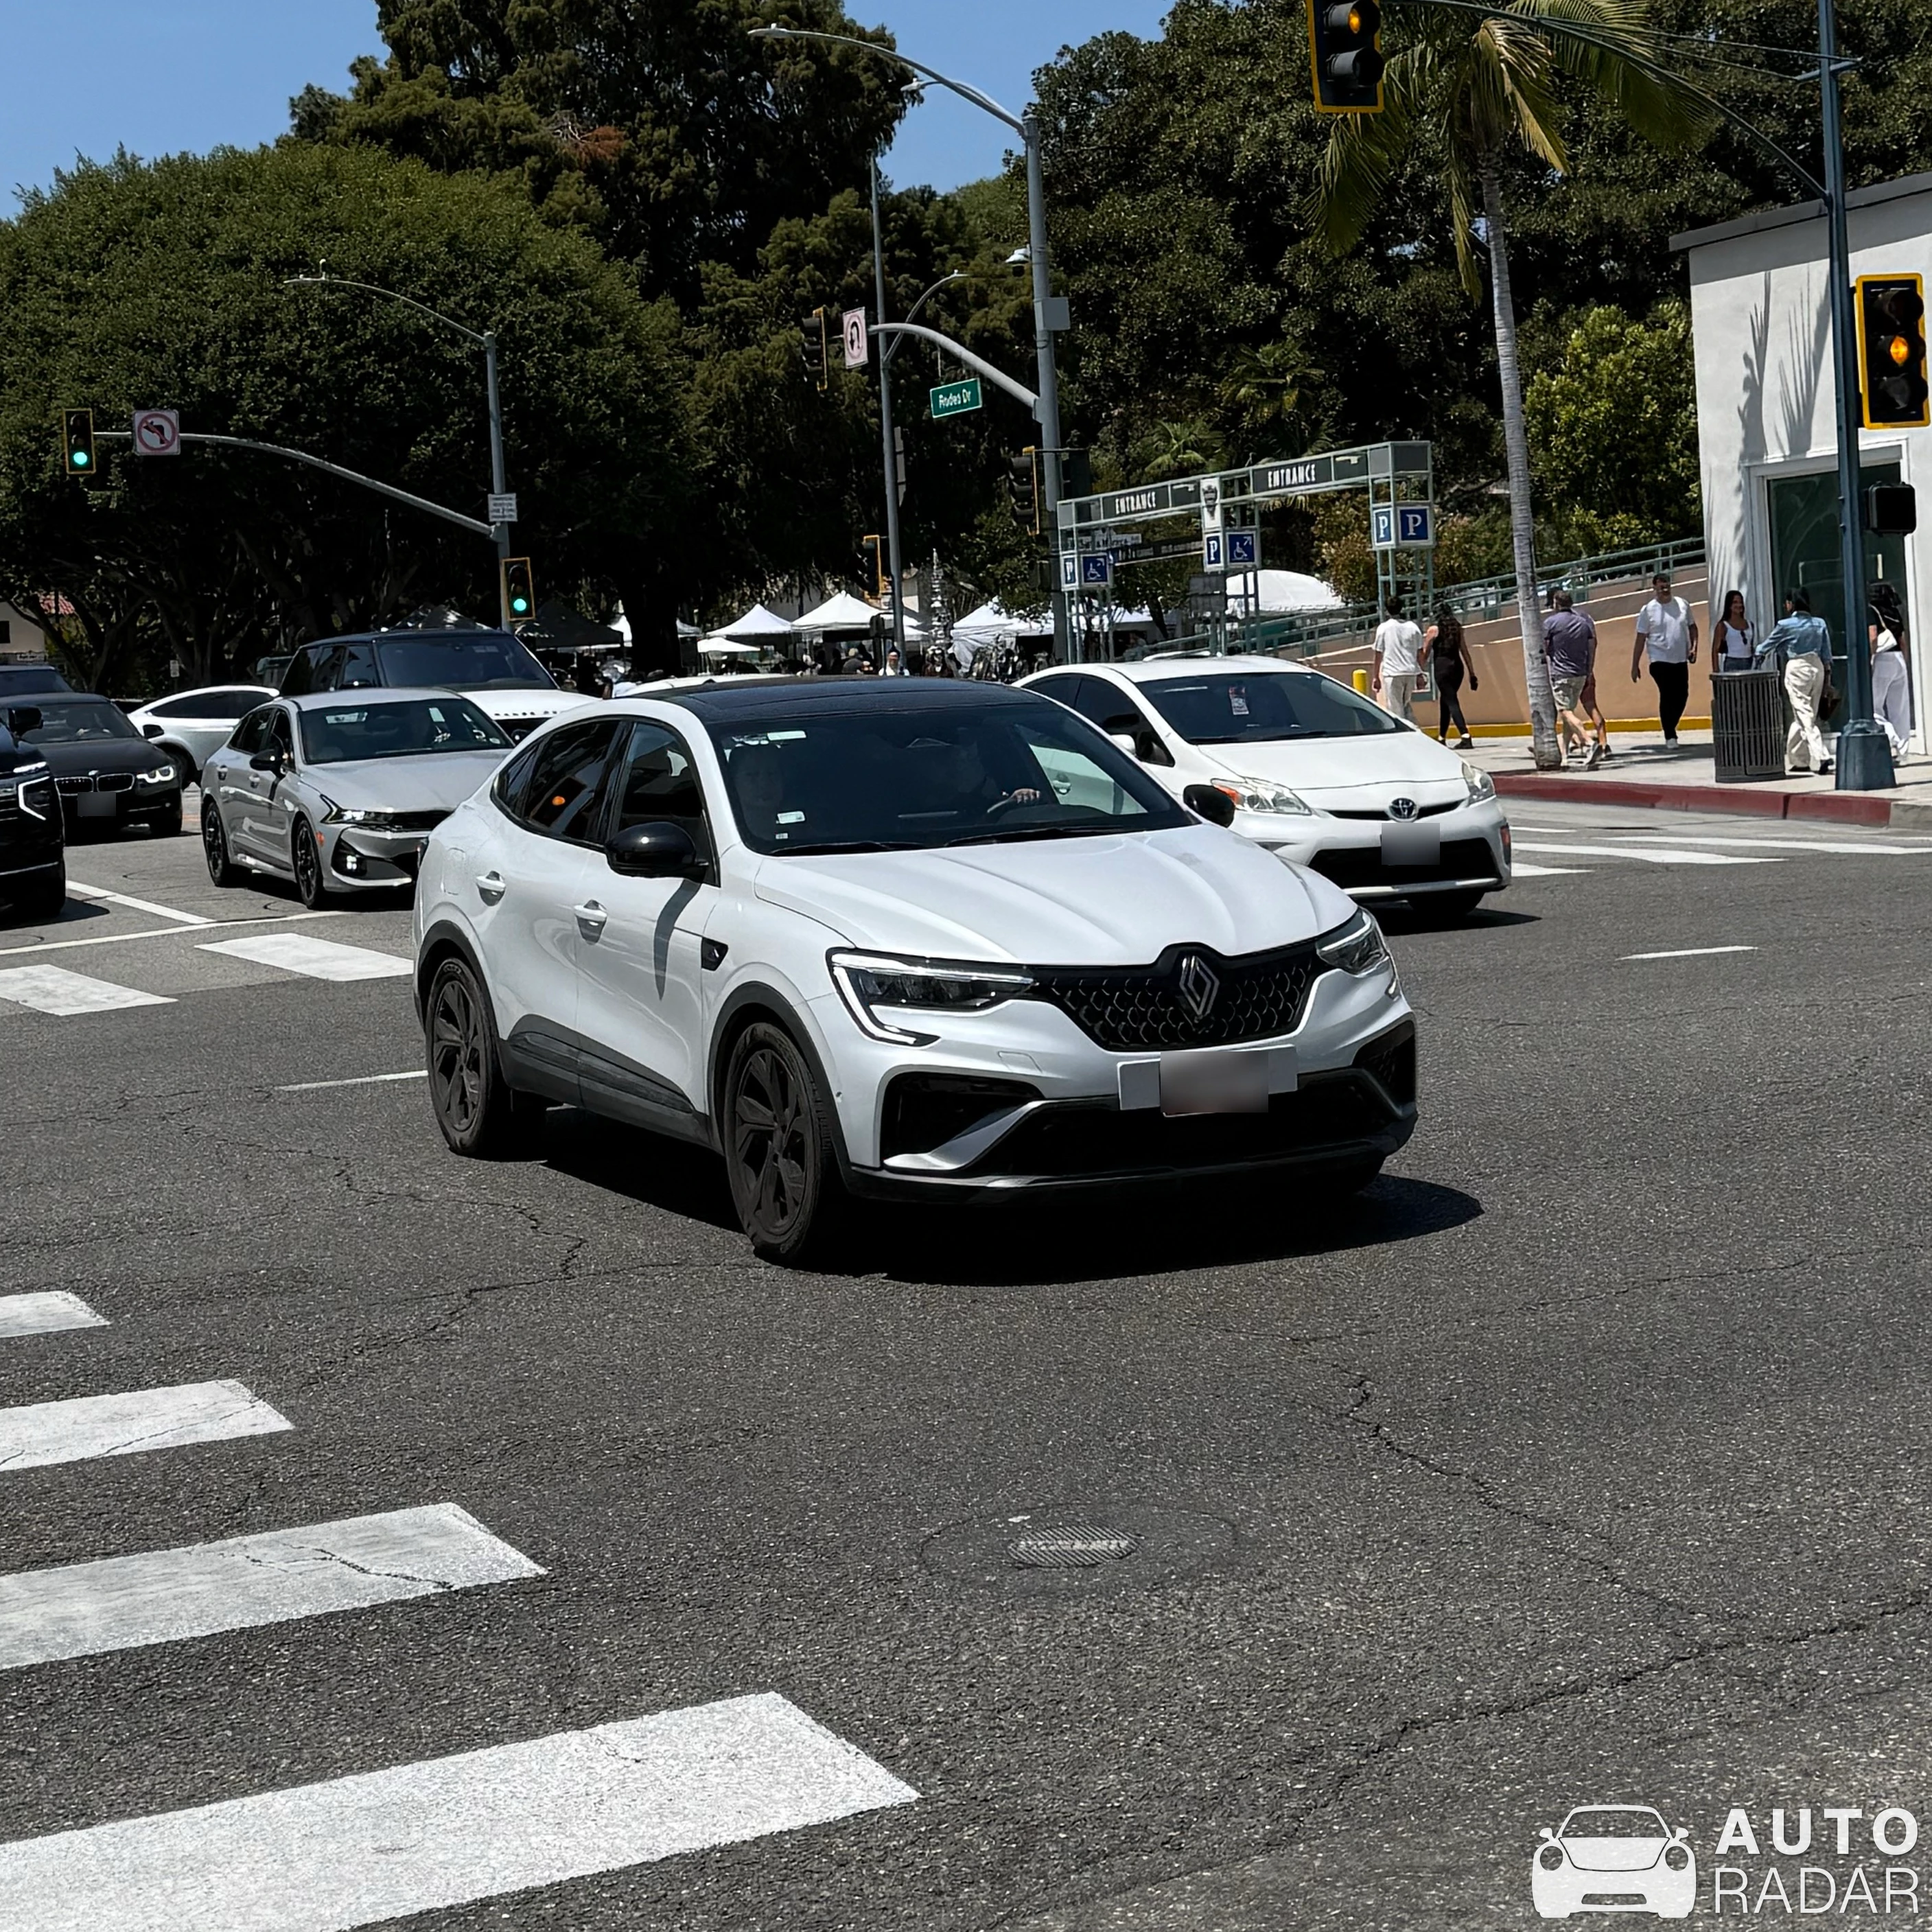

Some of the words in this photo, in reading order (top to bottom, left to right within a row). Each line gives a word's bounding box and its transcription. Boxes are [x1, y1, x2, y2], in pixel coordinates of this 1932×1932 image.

[1268, 464, 1316, 489] ENTRANCE
[1115, 491, 1156, 515] ENTRANCE
[1378, 515, 1388, 539] P
[1406, 514, 1422, 536] P
[1209, 540, 1218, 561] P
